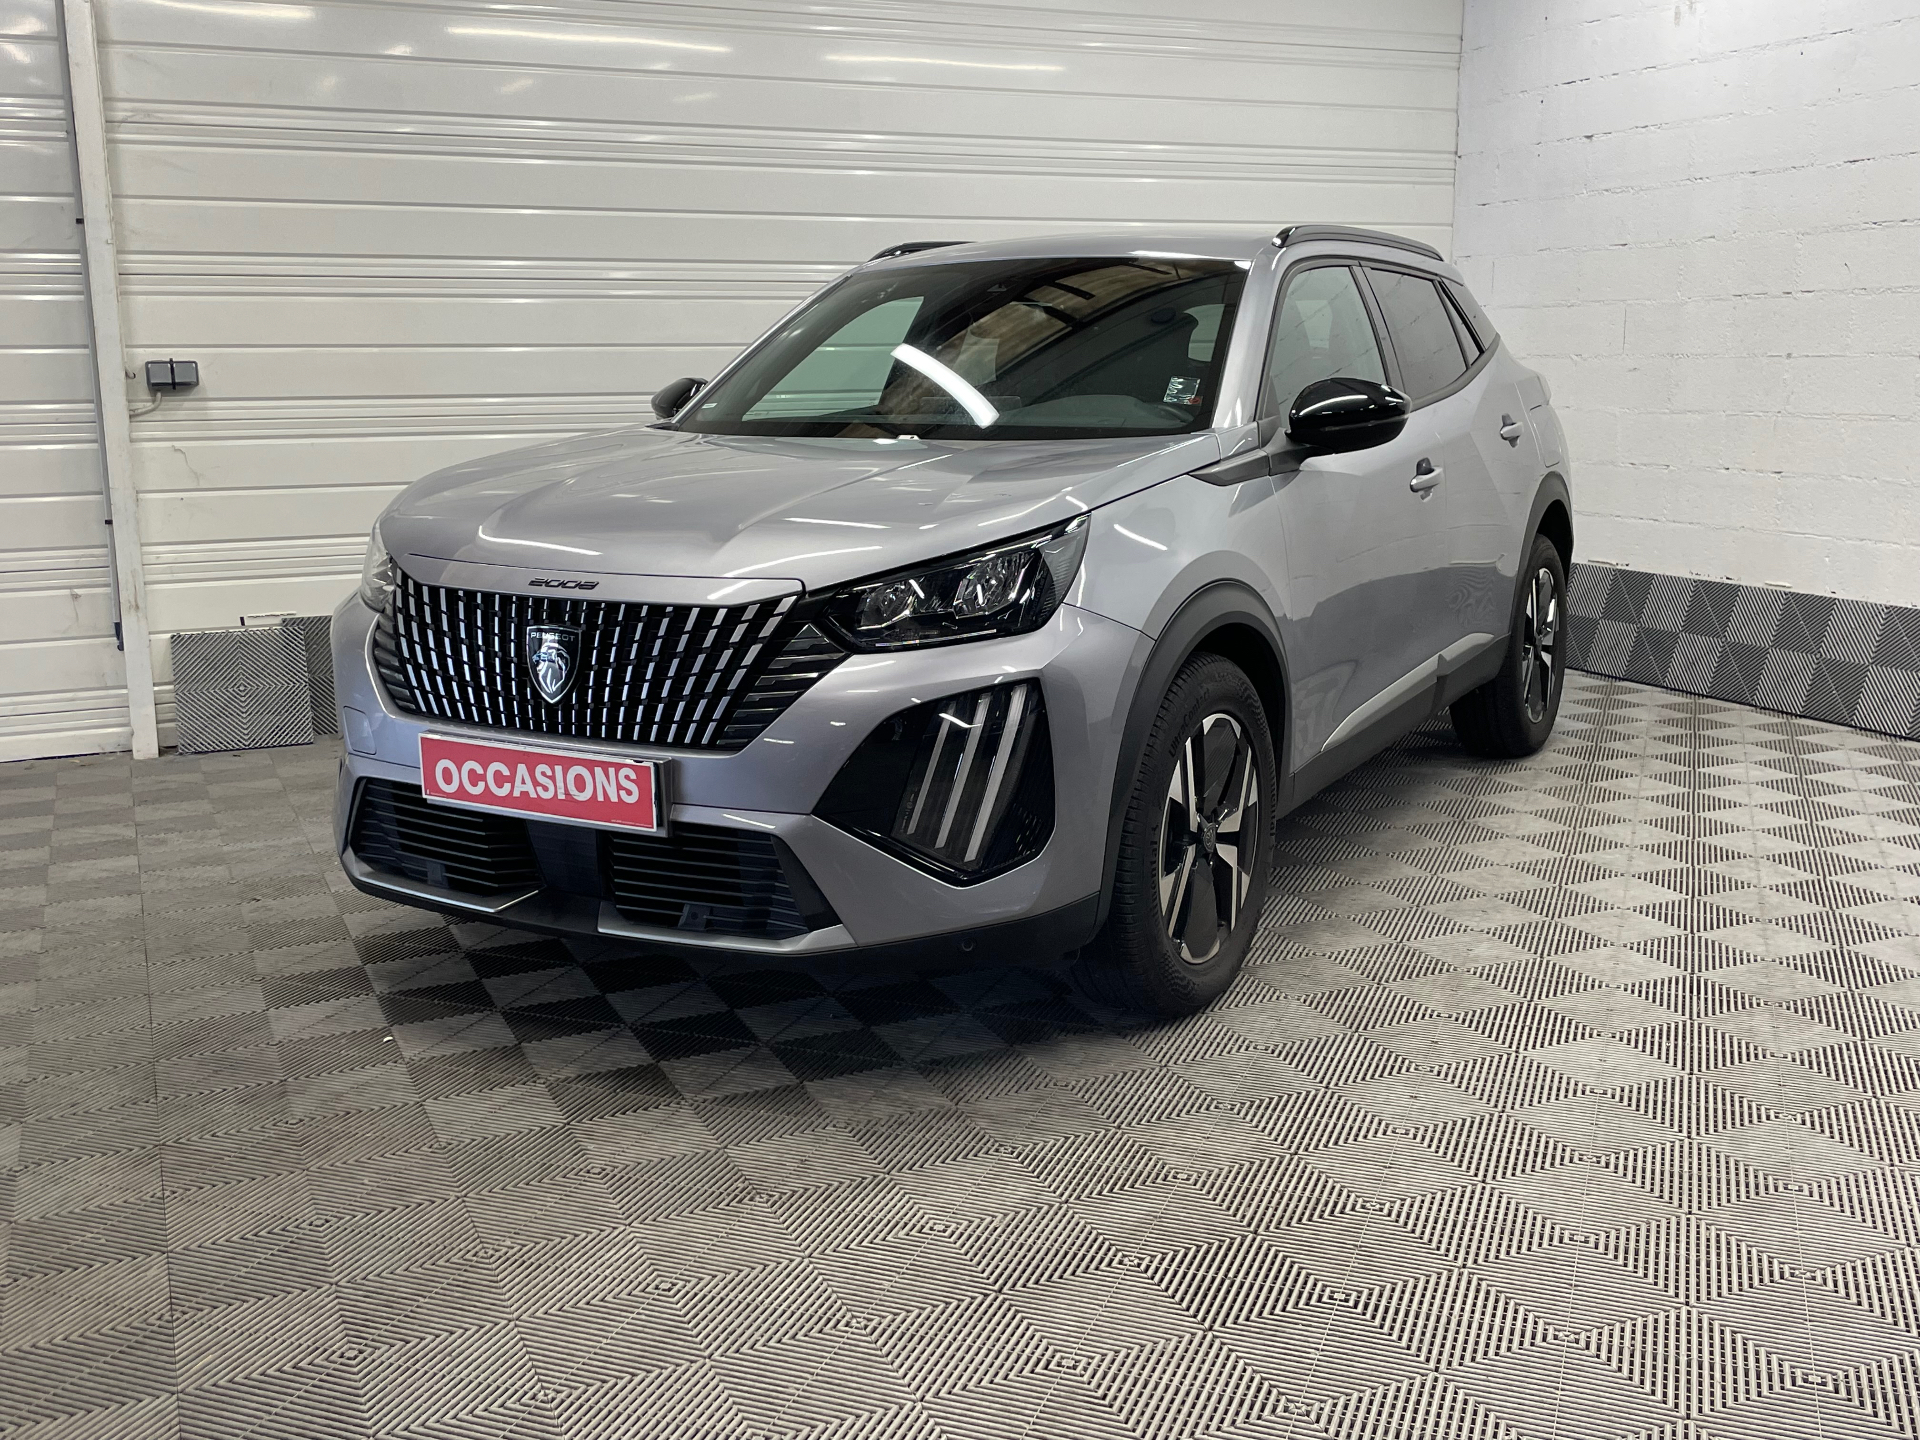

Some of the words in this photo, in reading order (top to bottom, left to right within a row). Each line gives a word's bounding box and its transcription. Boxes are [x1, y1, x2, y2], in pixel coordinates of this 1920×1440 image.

[528, 577, 599, 590] 2008
[530, 631, 575, 641] PEUGEOT
[435, 758, 639, 804] OCCASIONS
